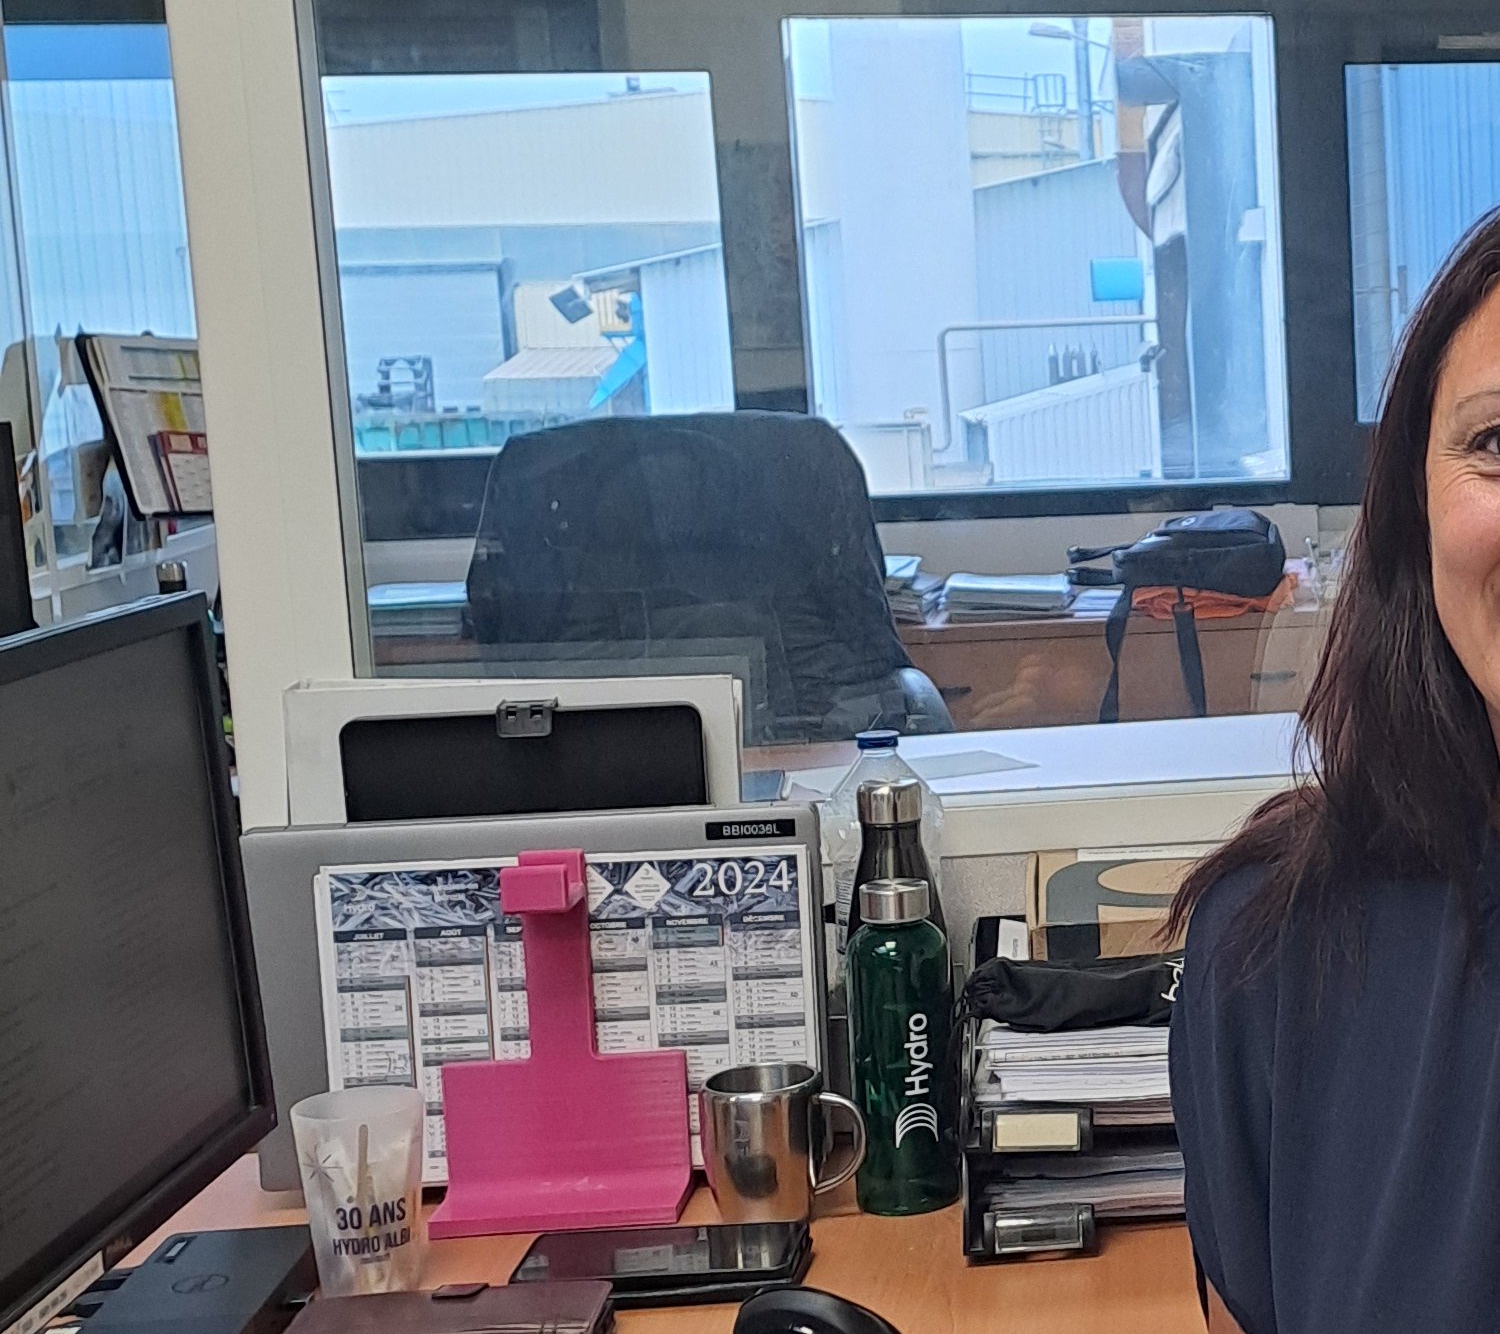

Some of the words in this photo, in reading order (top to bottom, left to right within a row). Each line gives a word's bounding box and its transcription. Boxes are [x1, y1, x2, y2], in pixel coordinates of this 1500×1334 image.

[693, 860, 793, 897] 2024
[903, 1012, 934, 1097] Hydro
[335, 1207, 362, 1230] 30
[369, 1197, 406, 1227] ANS
[333, 1235, 381, 1256] HYDRO
